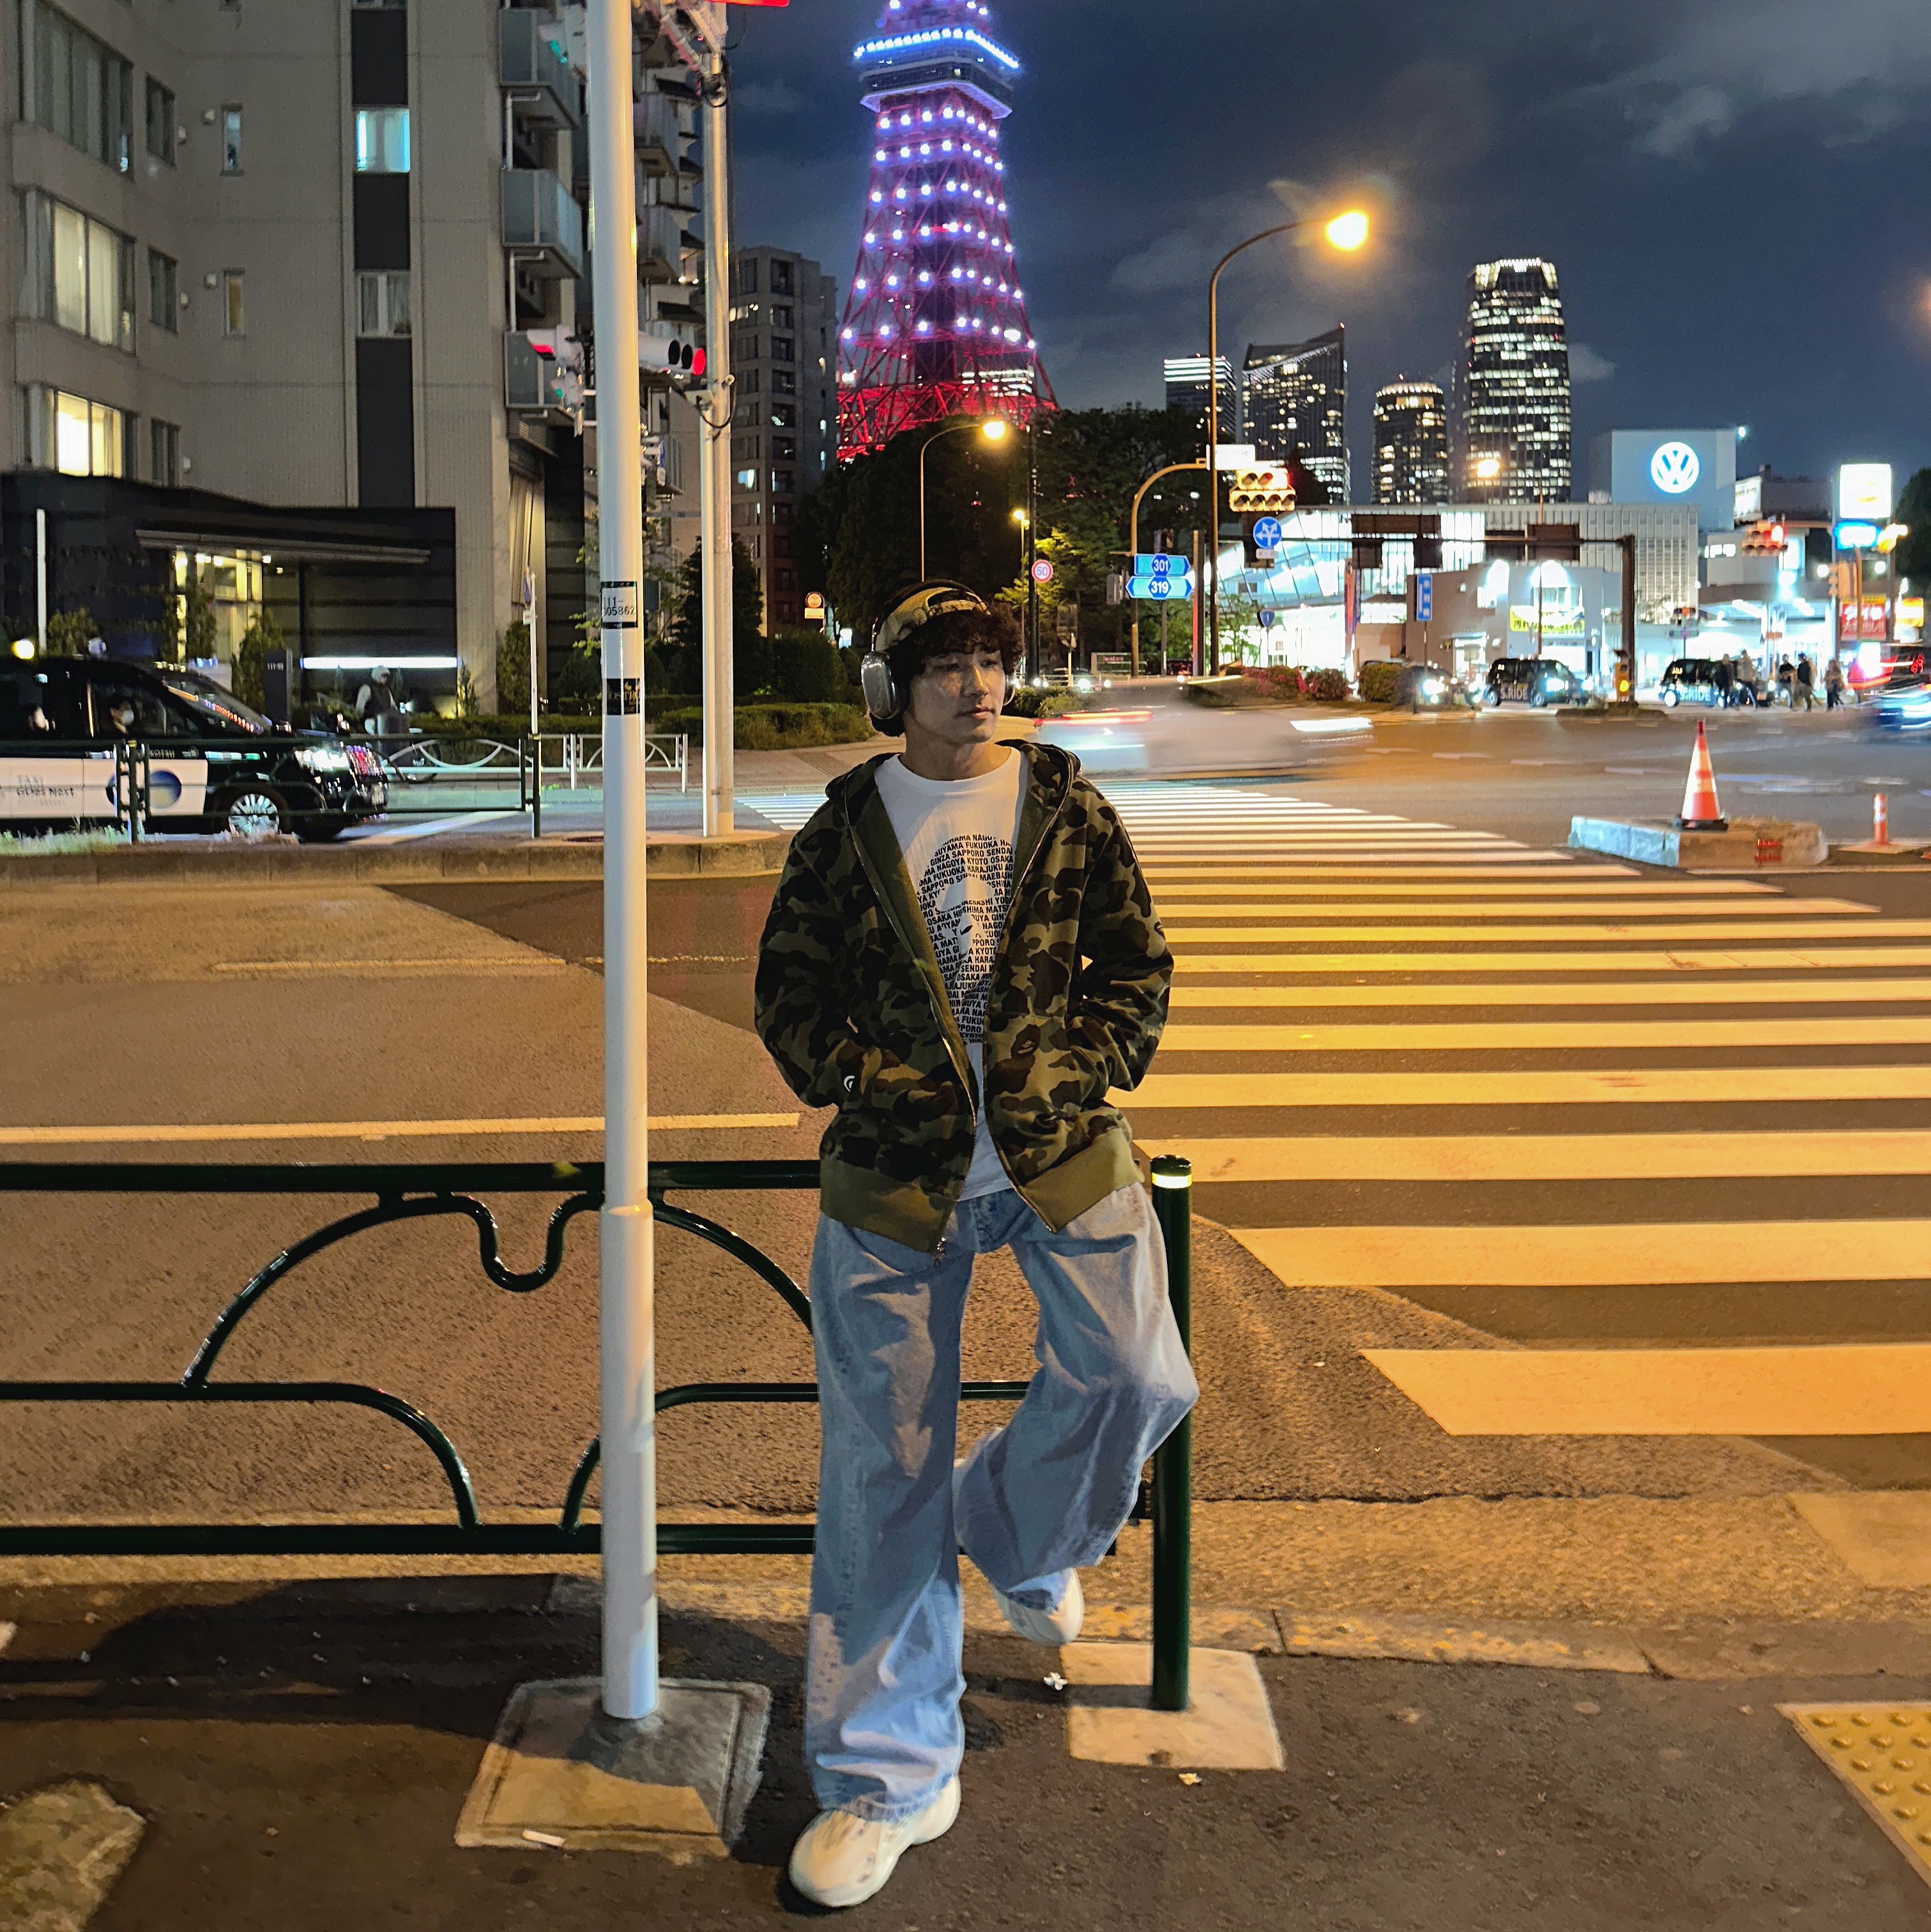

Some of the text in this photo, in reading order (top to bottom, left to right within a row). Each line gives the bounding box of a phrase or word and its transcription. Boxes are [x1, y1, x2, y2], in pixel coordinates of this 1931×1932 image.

[1037, 567, 1048, 576] 50
[1153, 559, 1169, 572] 301
[1150, 581, 1169, 594] 319
[965, 840, 998, 849] FUKUOKA
[930, 847, 1013, 866] GINZA SAPPORO SENDAI
[937, 858, 966, 871] NAGOYA
[991, 855, 1014, 863] OSAKA
[933, 866, 966, 880] FUKUOKA
[967, 864, 1003, 874] HARAJUKU
[921, 878, 954, 894] SAPPORO
[927, 913, 952, 925] OSAKA
[961, 964, 987, 973] SENDAI
[957, 973, 980, 982] OSAKA
